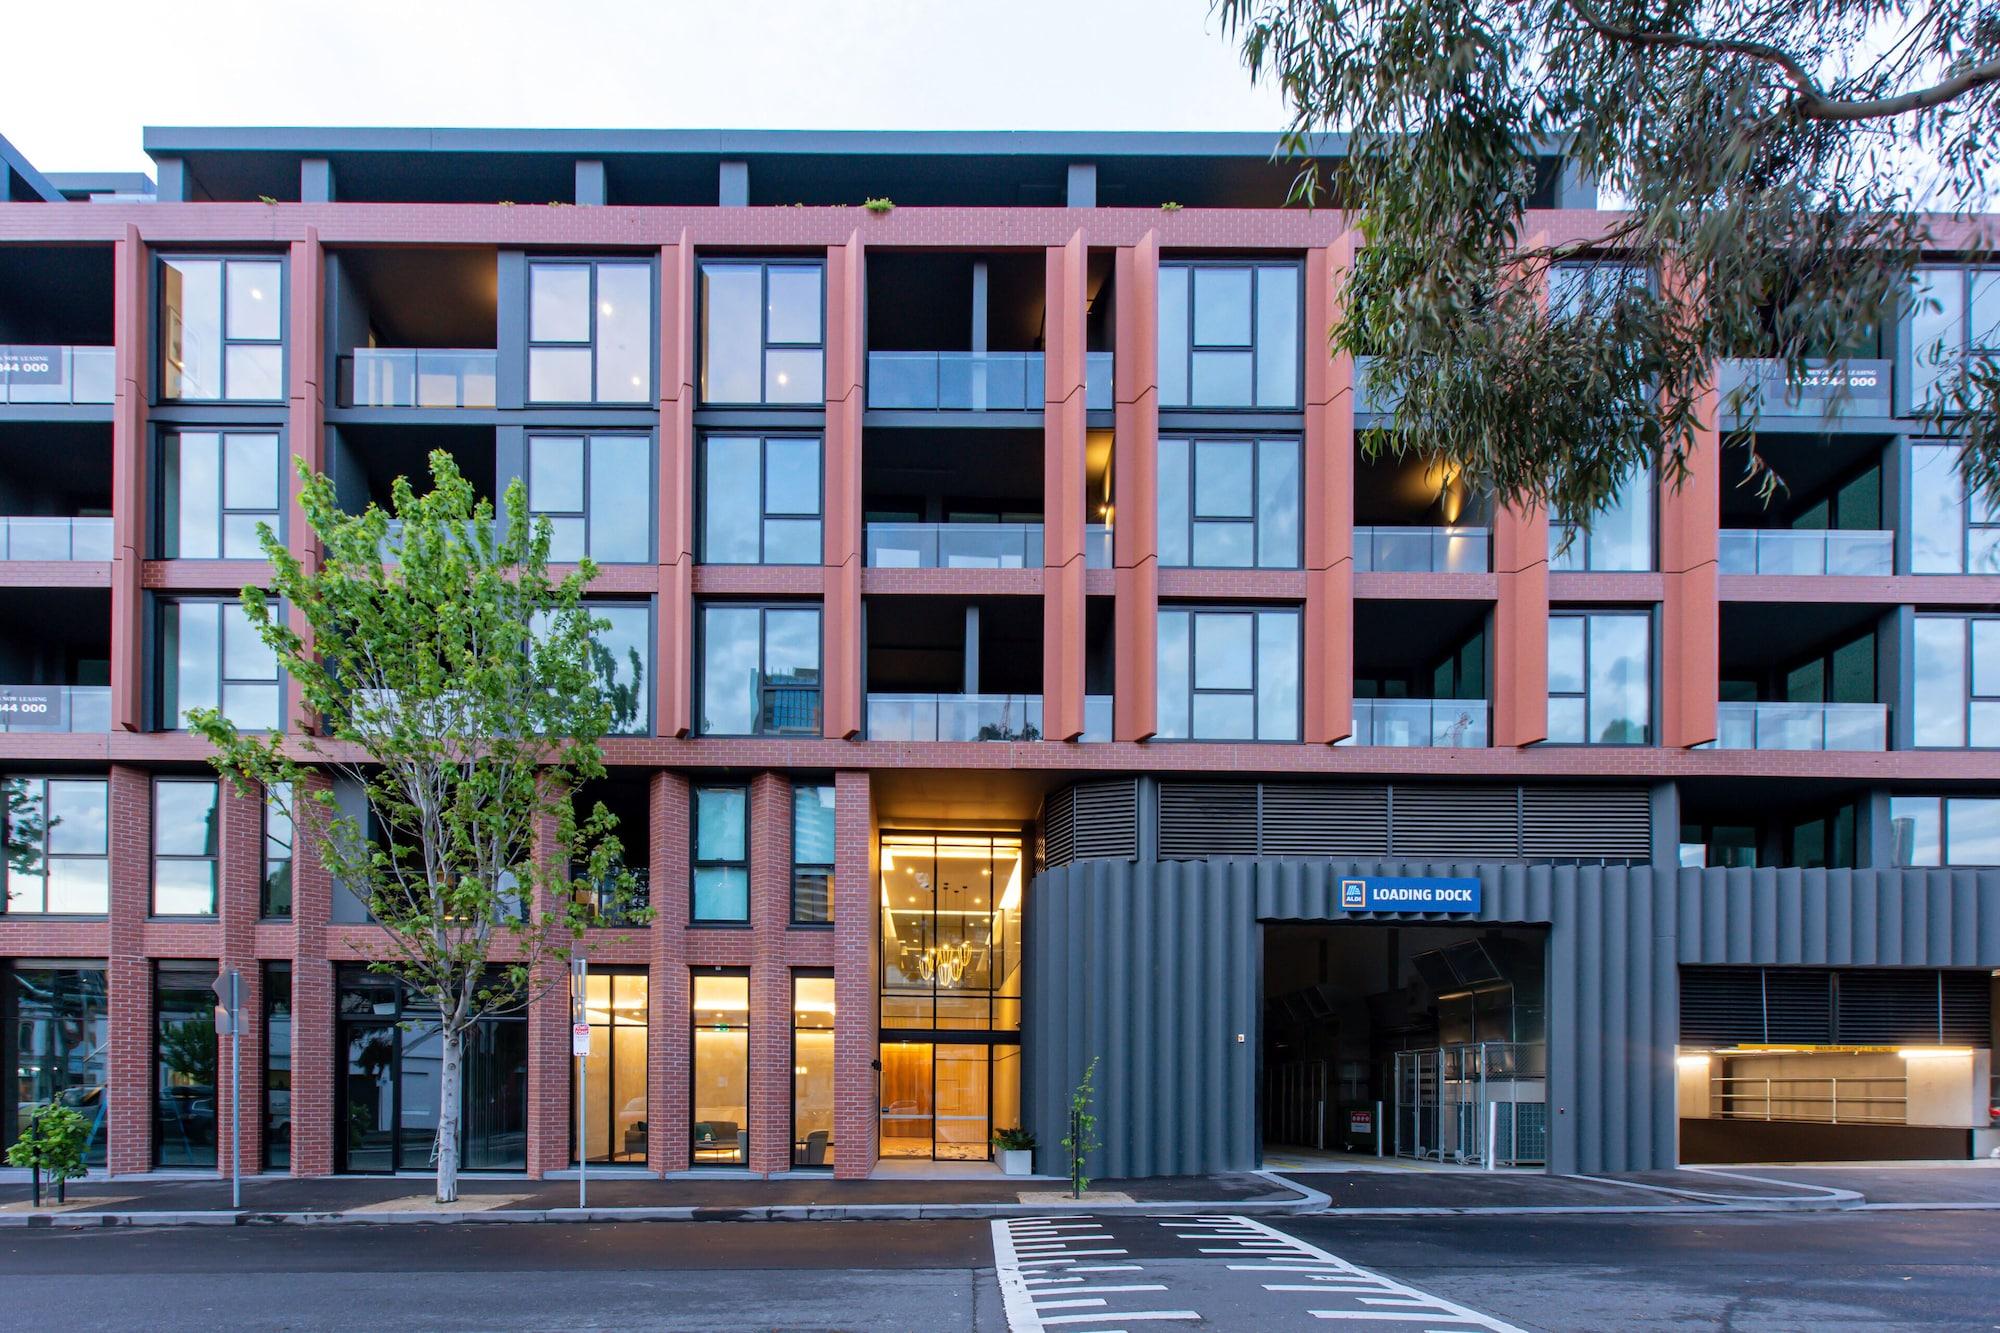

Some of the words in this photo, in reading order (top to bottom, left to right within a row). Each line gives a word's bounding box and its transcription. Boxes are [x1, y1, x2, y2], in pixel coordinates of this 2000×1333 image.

[23, 363, 49, 372] 000
[1849, 377, 1877, 386] 000
[0, 703, 18, 712] 44
[21, 703, 47, 712] 000
[1373, 888, 1432, 901] LOADING
[1435, 889, 1473, 901] DOCK
